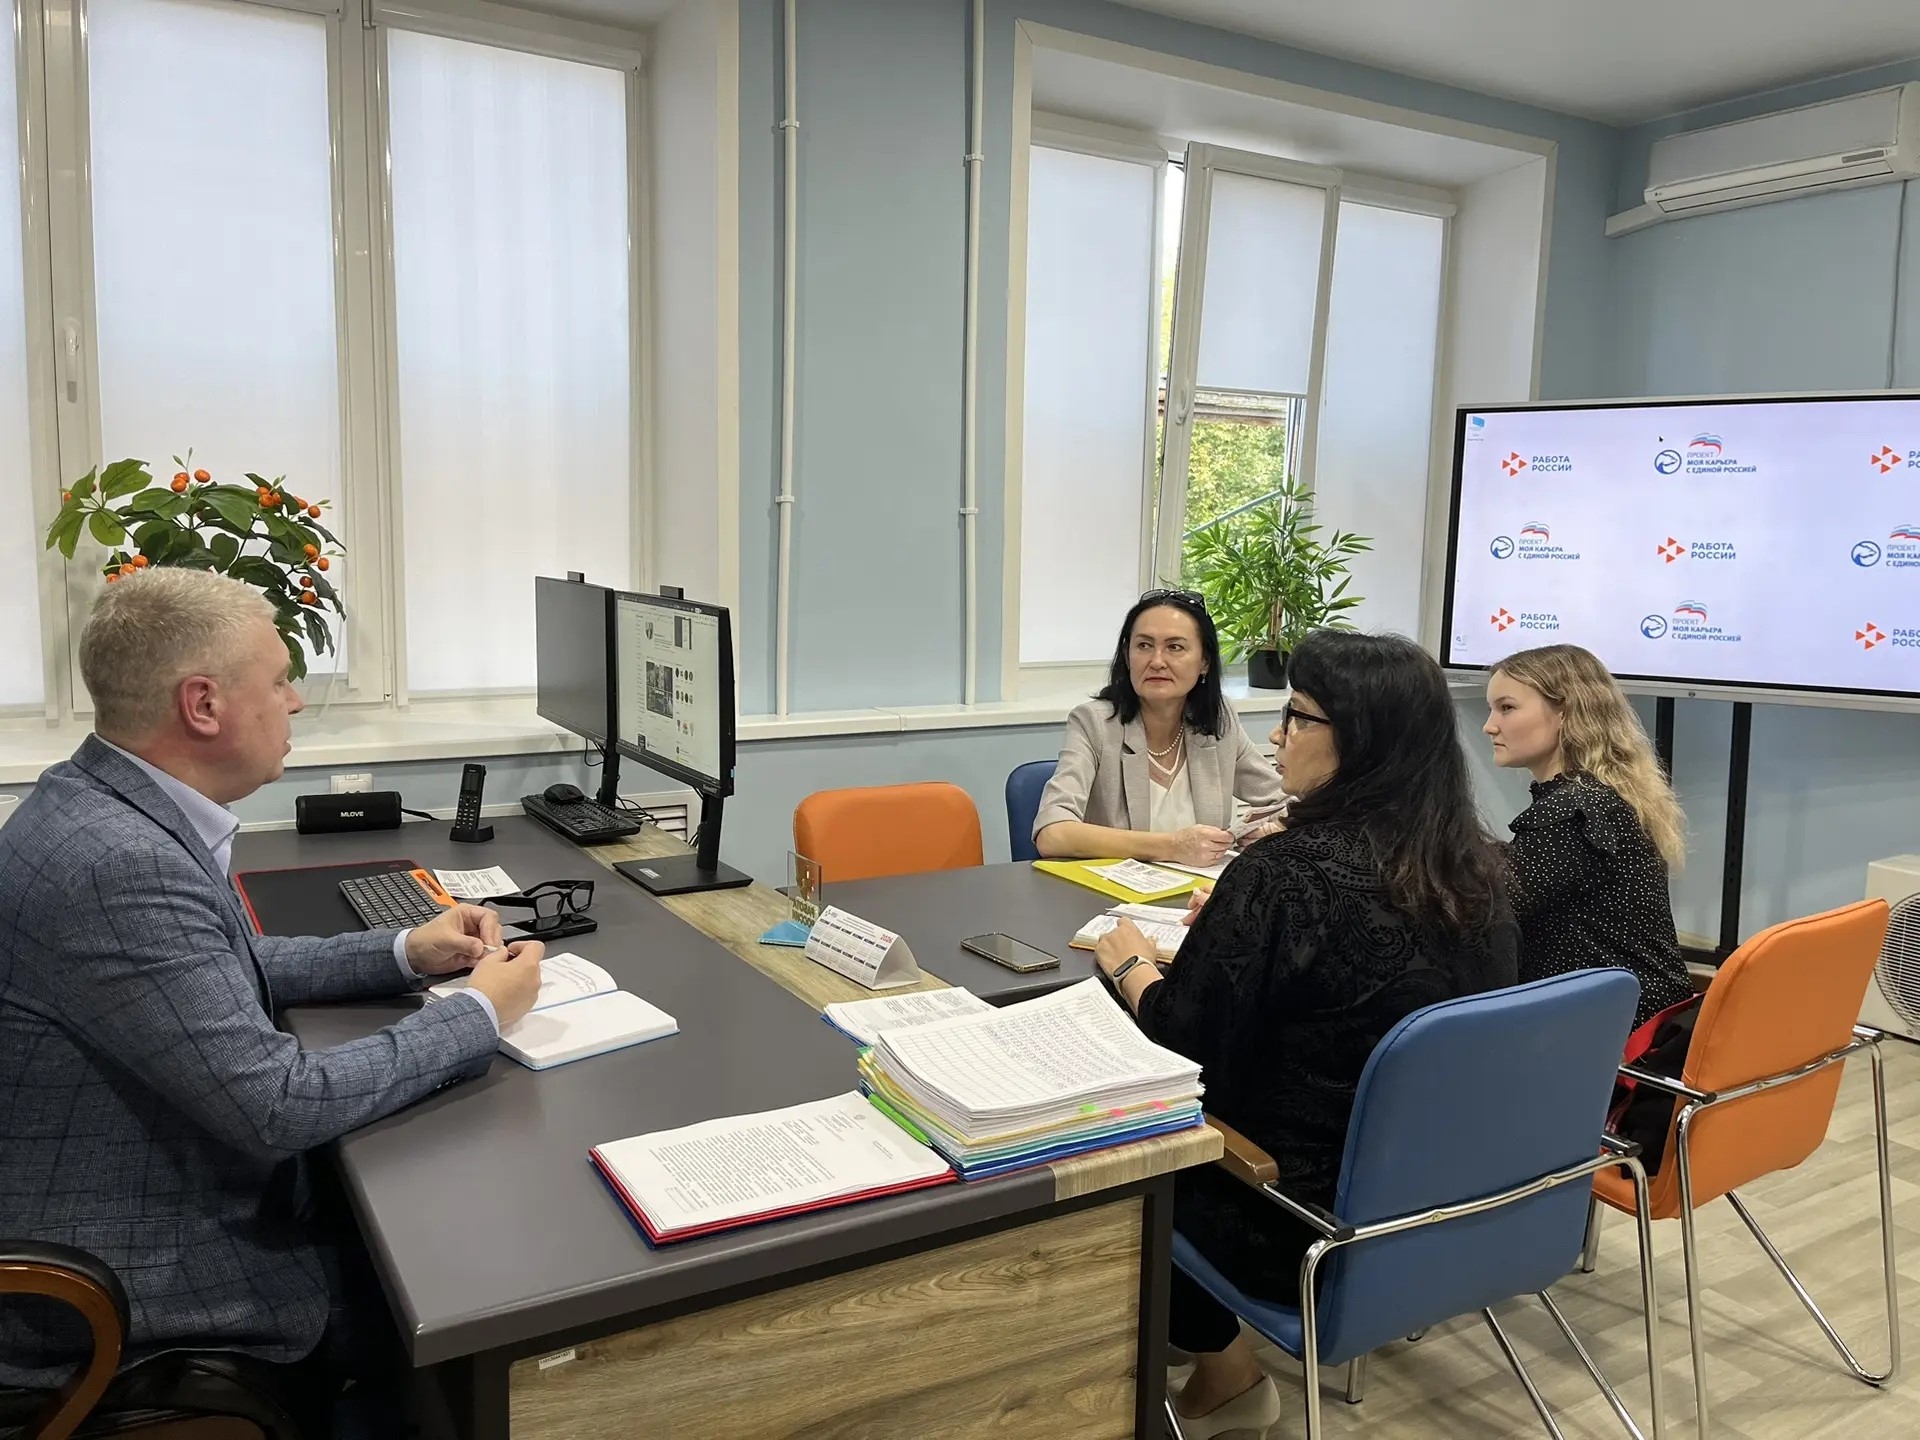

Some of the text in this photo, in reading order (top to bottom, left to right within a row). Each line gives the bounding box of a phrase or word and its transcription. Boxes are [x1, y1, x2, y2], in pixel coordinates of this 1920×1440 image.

[1532, 455, 1571, 463] РАБОТА
[1531, 464, 1572, 472] РОССИИ
[1692, 466, 1722, 474] ЕДИНОЙ
[1723, 465, 1757, 473] РОССИЕЙ
[1691, 542, 1734, 550] РАБОТА
[1691, 551, 1736, 559] РОССИИ
[1520, 613, 1558, 621] РАБОТА
[1519, 621, 1560, 630] РОССИИ
[1708, 634, 1742, 642] РОССИЕЙ
